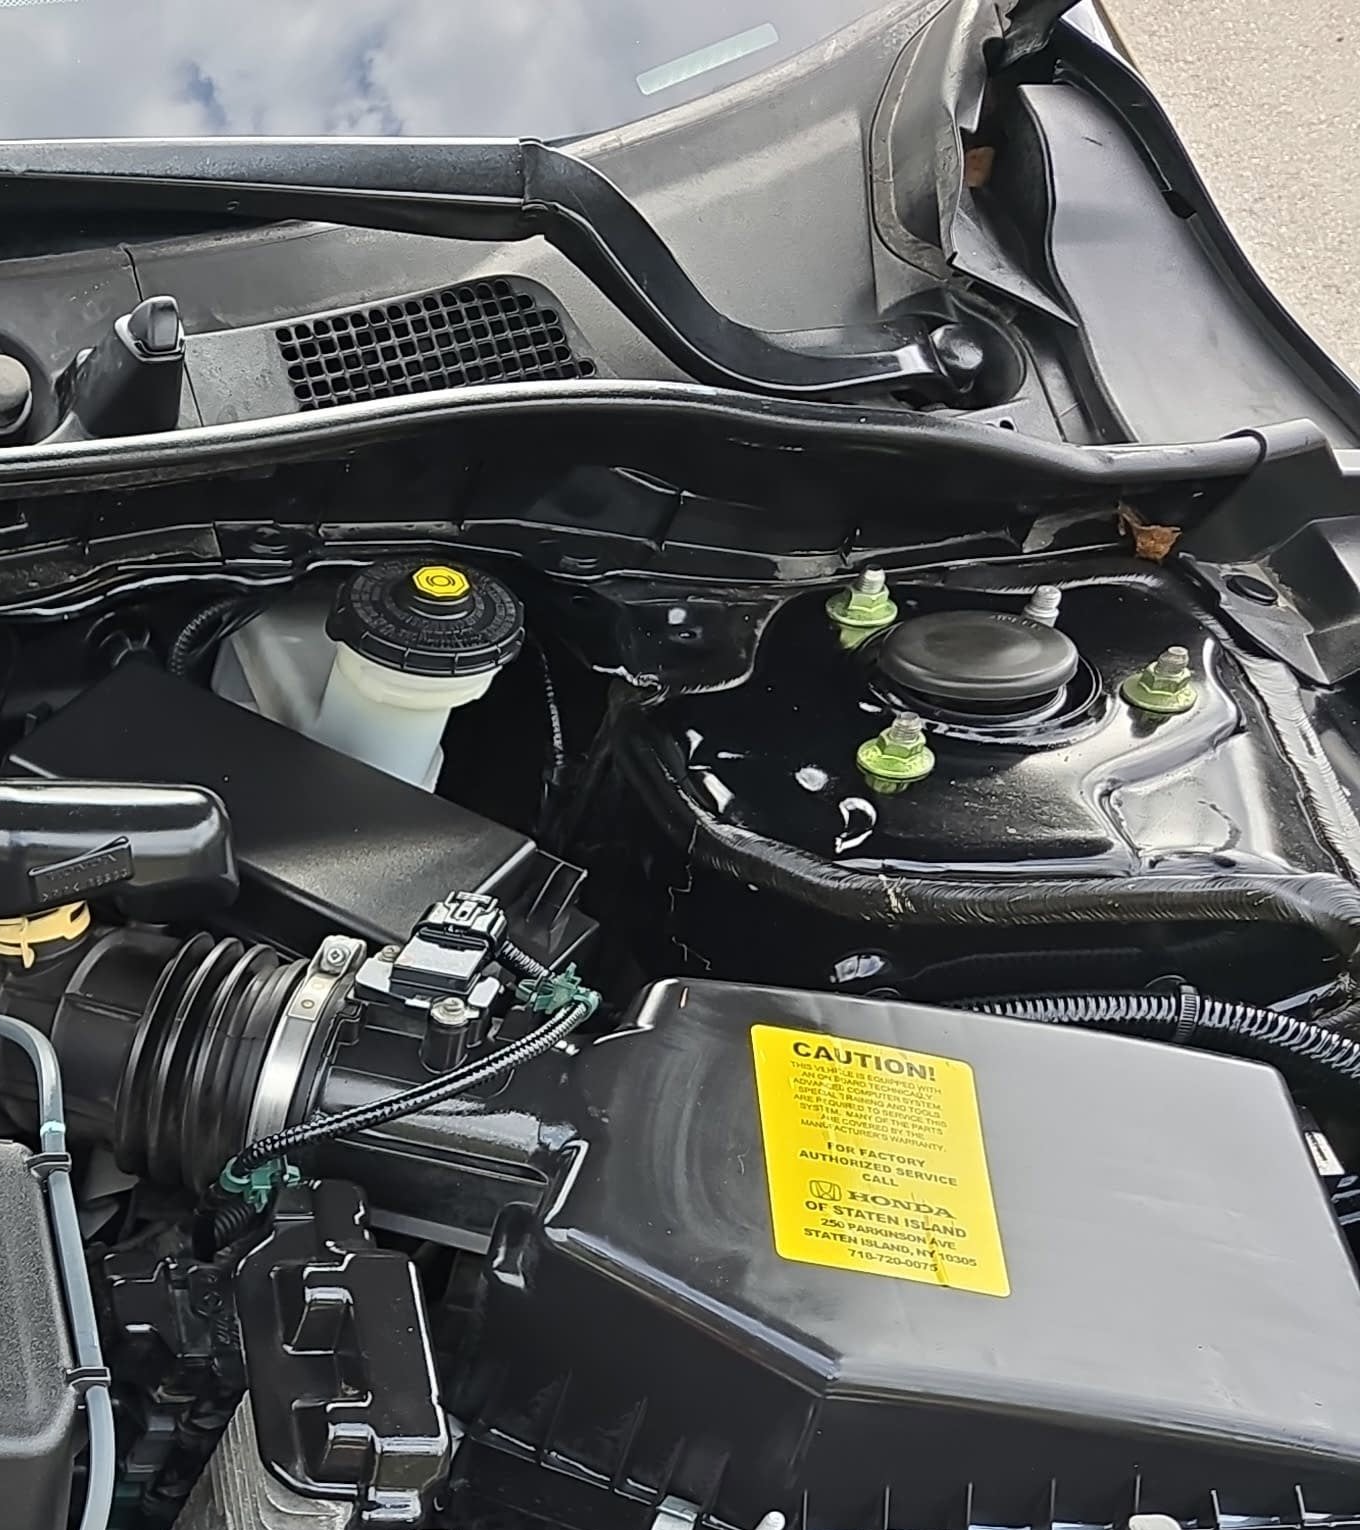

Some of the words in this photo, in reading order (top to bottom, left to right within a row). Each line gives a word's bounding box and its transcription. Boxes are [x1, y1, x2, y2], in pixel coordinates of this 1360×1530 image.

[793, 1042, 935, 1081] CAUTION!
[847, 1087, 900, 1101] COMPUTER
[868, 1074, 914, 1089] EQUIPPED
[919, 1084, 941, 1093] WITH
[794, 1094, 814, 1103] ARE
[883, 1109, 924, 1124] SERVICE
[926, 1119, 948, 1128] THIS
[887, 1103, 906, 1111] AND
[842, 1119, 889, 1133] COVERED
[846, 1111, 872, 1120] MANY
[891, 1119, 909, 1128] THE
[911, 1123, 943, 1135] PARTS
[828, 1142, 856, 1154] FOR
[860, 1148, 925, 1167] FACTORY
[800, 1150, 891, 1173] AUTHORIZED
[896, 1167, 957, 1186] SERVICE
[862, 1173, 899, 1187] CALL
[848, 1191, 957, 1220] HONDA
[805, 1201, 827, 1211] OF
[833, 1205, 899, 1225] STATEN
[905, 1218, 967, 1238] ISLAND
[820, 1218, 845, 1228] 250
[848, 1223, 926, 1244] PARKINSON
[930, 1238, 956, 1250] AVE
[804, 1228, 857, 1244] STATEN
[917, 1248, 935, 1258] NY
[940, 1253, 976, 1267] 10305
[849, 1249, 938, 1271] 718-720-0075
